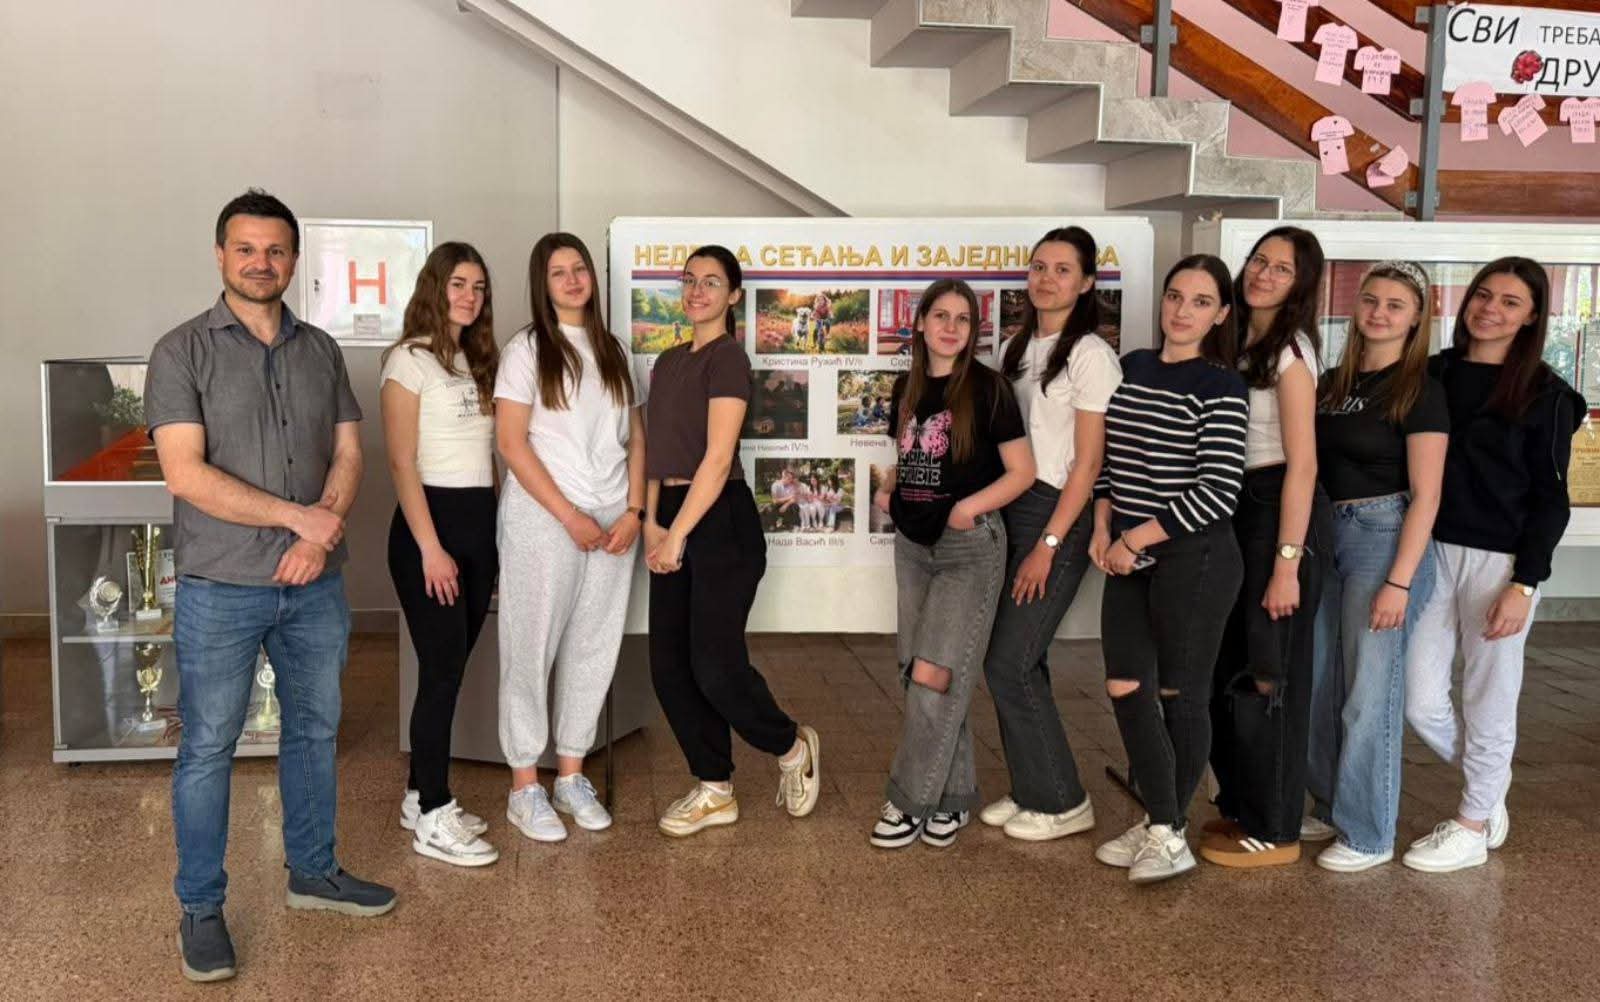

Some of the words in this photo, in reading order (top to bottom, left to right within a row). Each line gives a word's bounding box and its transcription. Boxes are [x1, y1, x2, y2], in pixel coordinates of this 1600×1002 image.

[759, 244, 884, 267] СЕЋАЊА
[891, 245, 909, 267] И
[763, 357, 809, 367] Кристина
